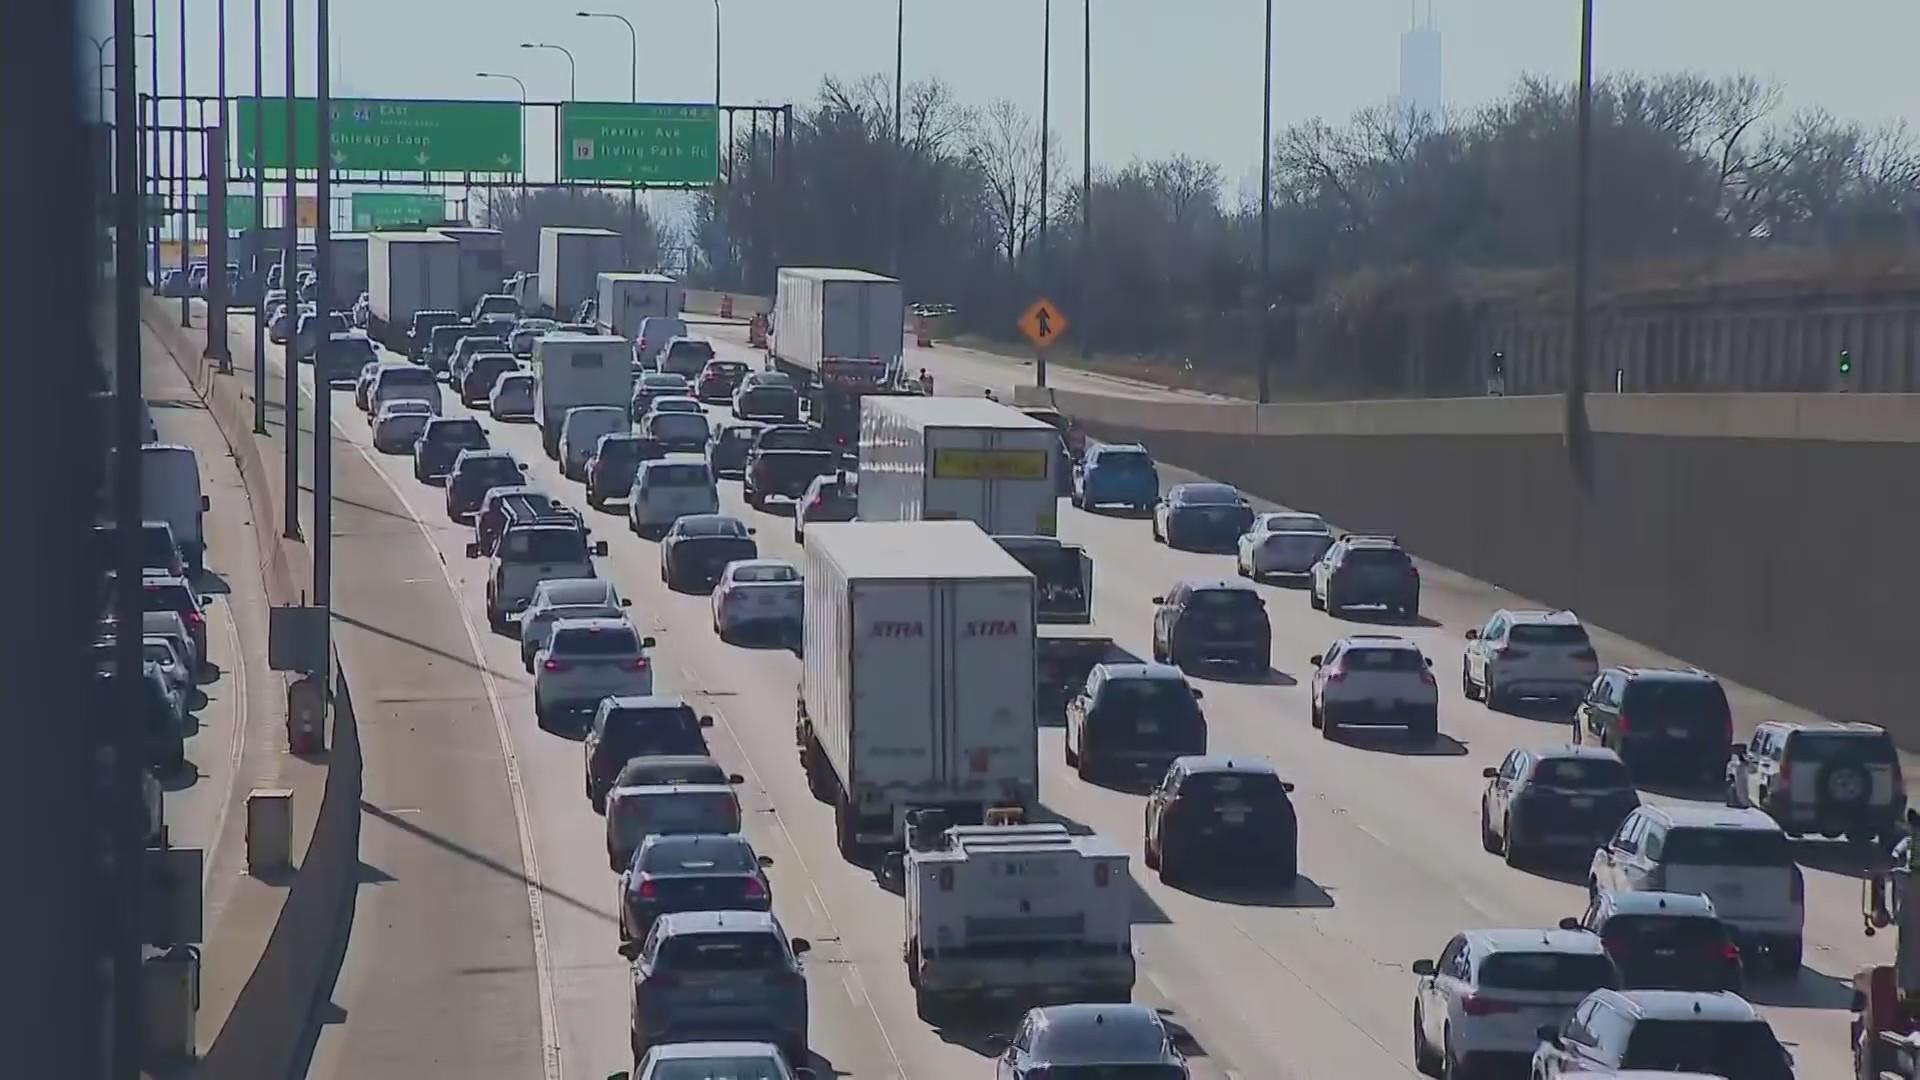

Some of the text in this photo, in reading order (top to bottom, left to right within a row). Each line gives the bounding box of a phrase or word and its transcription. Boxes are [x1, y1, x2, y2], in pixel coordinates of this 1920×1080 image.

[353, 111, 369, 121] 94
[331, 133, 430, 146] Chicago Loop
[578, 145, 589, 156] 19
[601, 143, 708, 158] Irving Park Rd
[871, 620, 924, 637] XTRA
[964, 620, 1017, 637] XTRA
